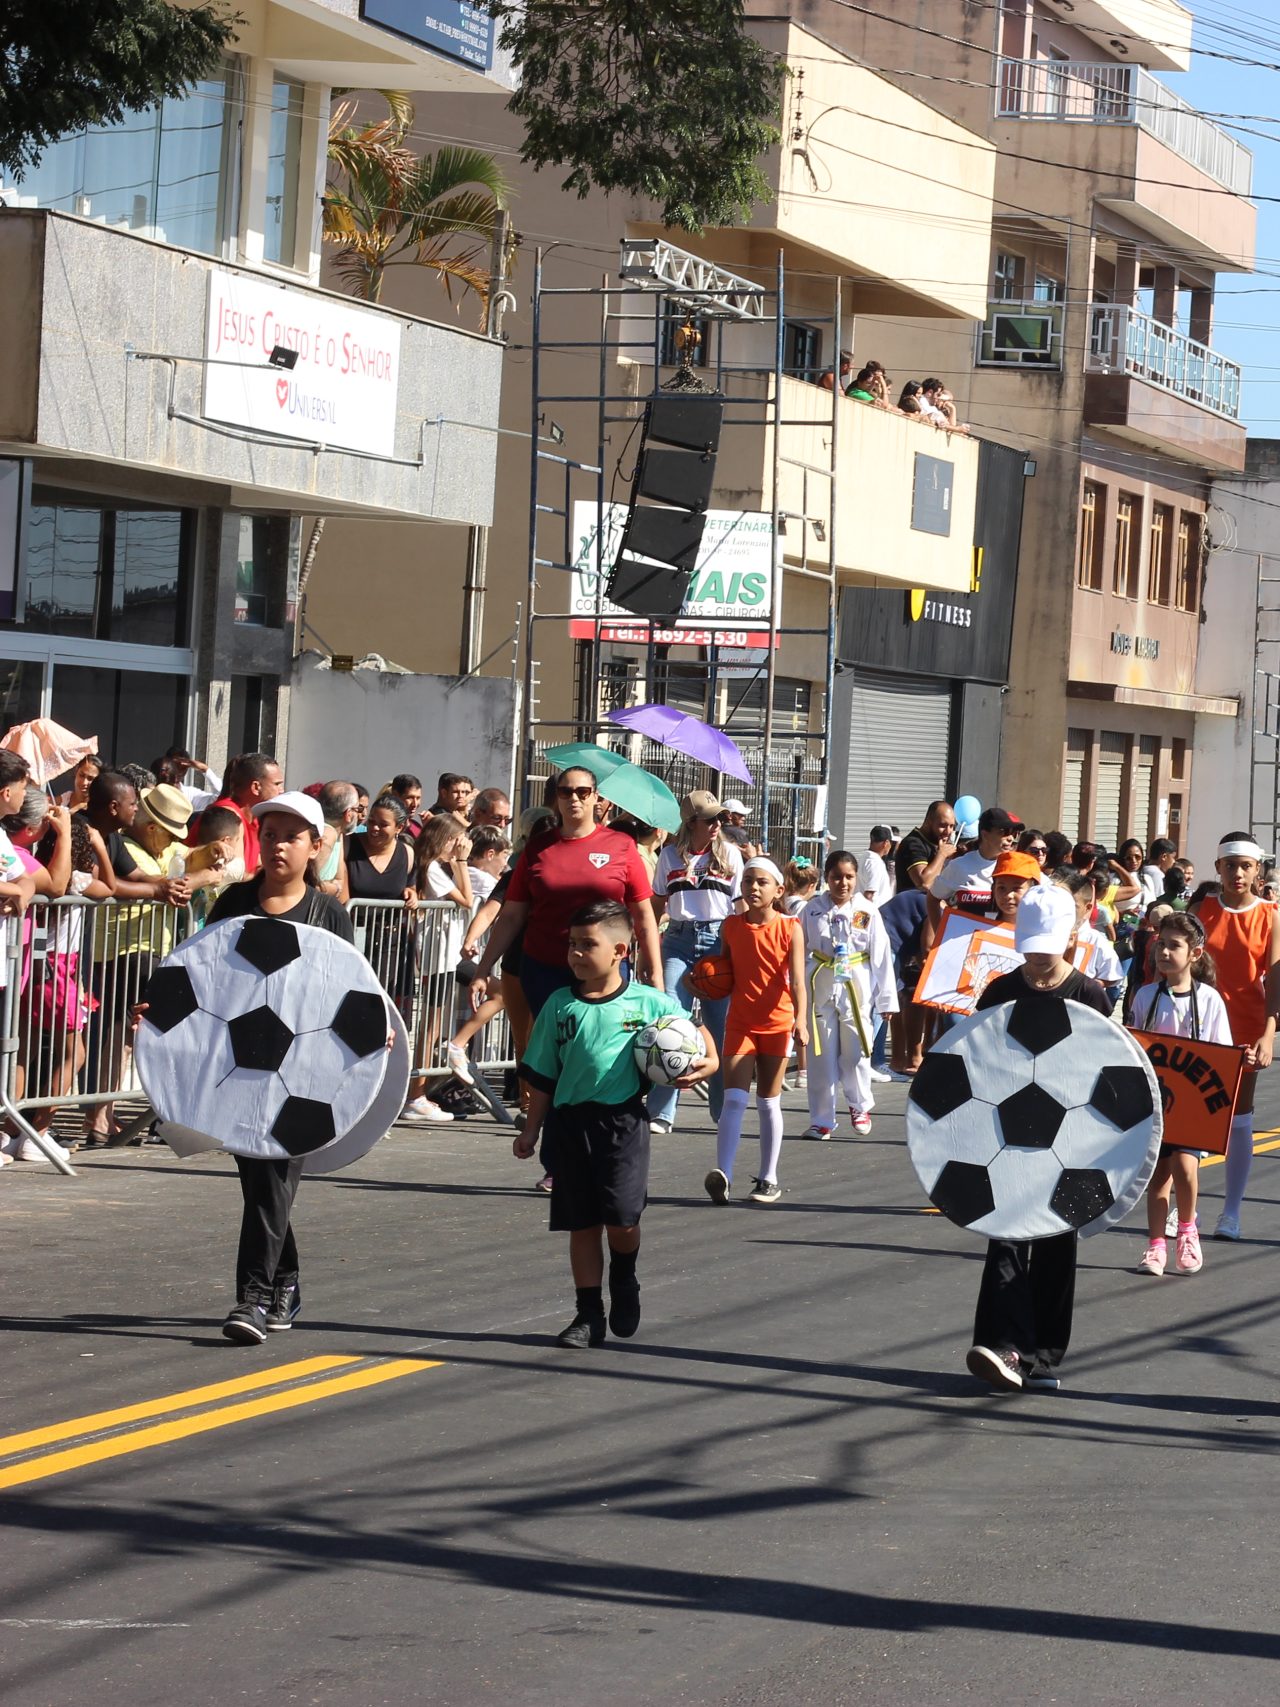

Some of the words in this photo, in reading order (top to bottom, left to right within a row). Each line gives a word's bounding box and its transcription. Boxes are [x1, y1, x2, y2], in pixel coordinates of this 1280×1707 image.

[216, 298, 254, 353] JESUS
[262, 311, 309, 361] CRISTO
[341, 332, 392, 382] SENHOR
[653, 628, 747, 646] 4692-5530
[924, 600, 971, 628] FITNESS
[1146, 1042, 1232, 1115] QUETE
